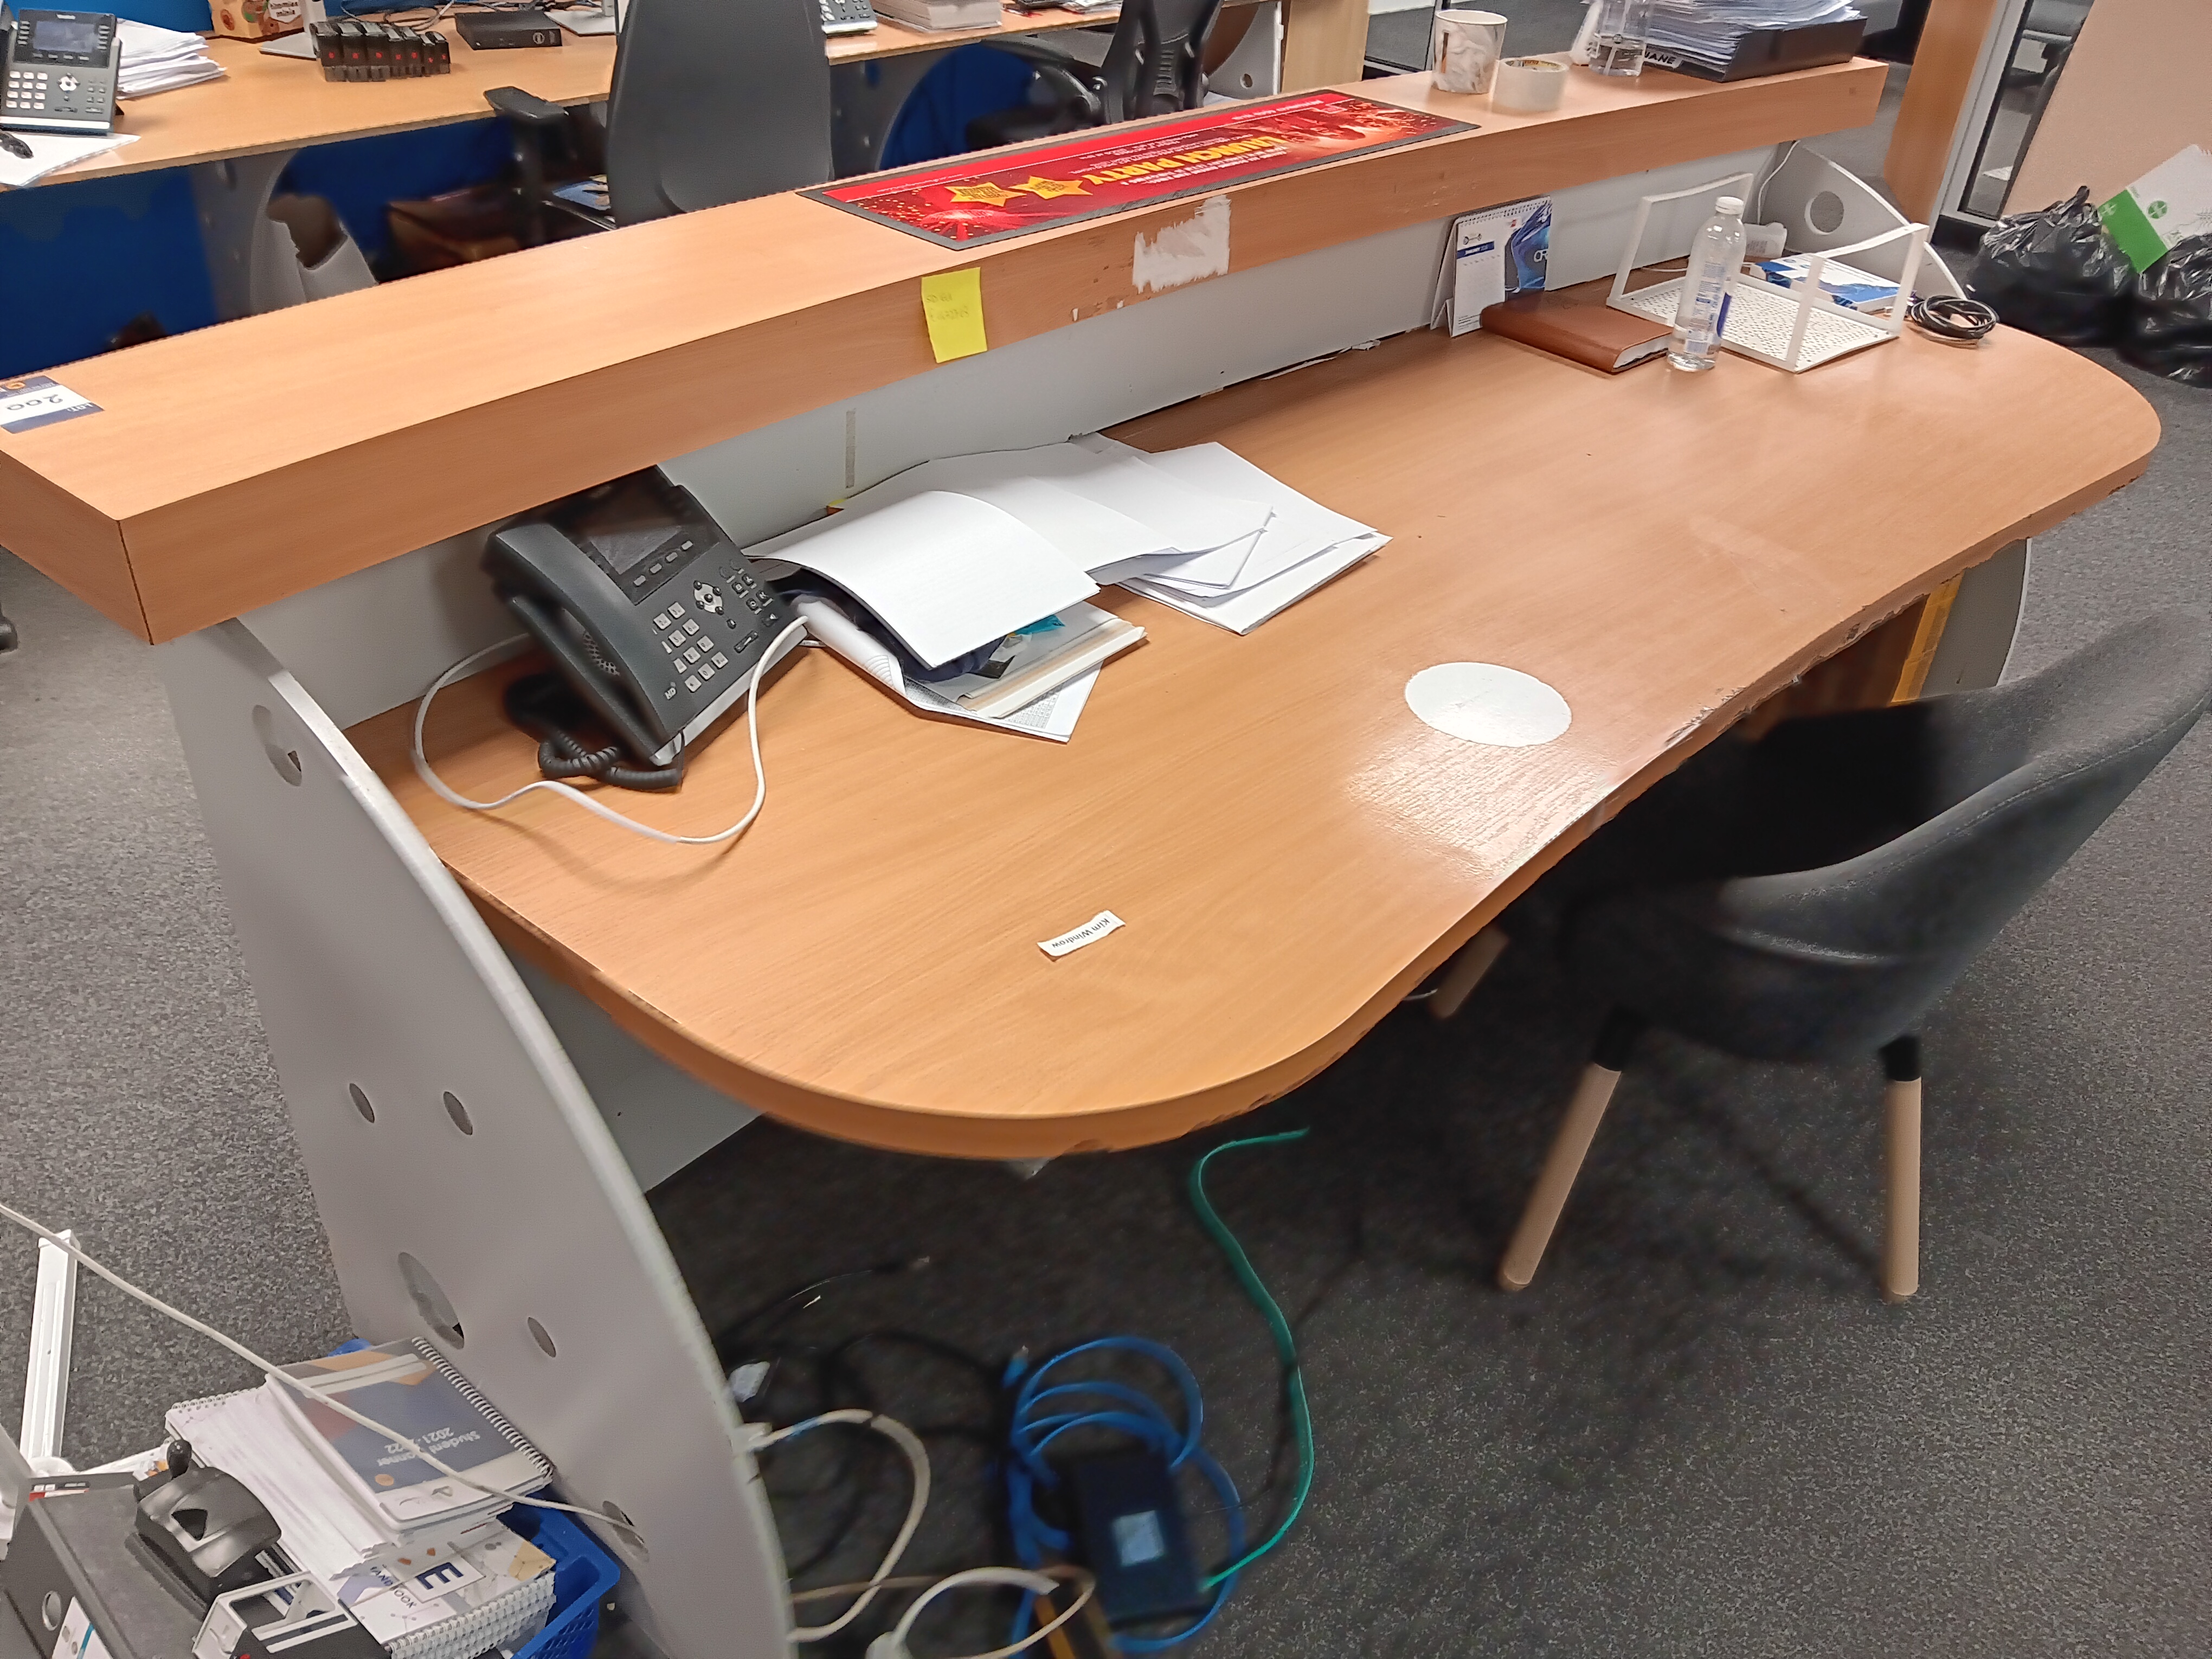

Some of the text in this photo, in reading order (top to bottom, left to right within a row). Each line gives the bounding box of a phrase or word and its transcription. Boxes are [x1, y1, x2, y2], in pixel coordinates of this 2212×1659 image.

[1173, 136, 1288, 164] LAUNCH
[1082, 158, 1185, 185] PARTY
[7, 394, 63, 411] 200
[1051, 917, 1111, 948] Kim Windrow
[428, 1430, 481, 1455] Student
[370, 1566, 417, 1609] ANDOOK
